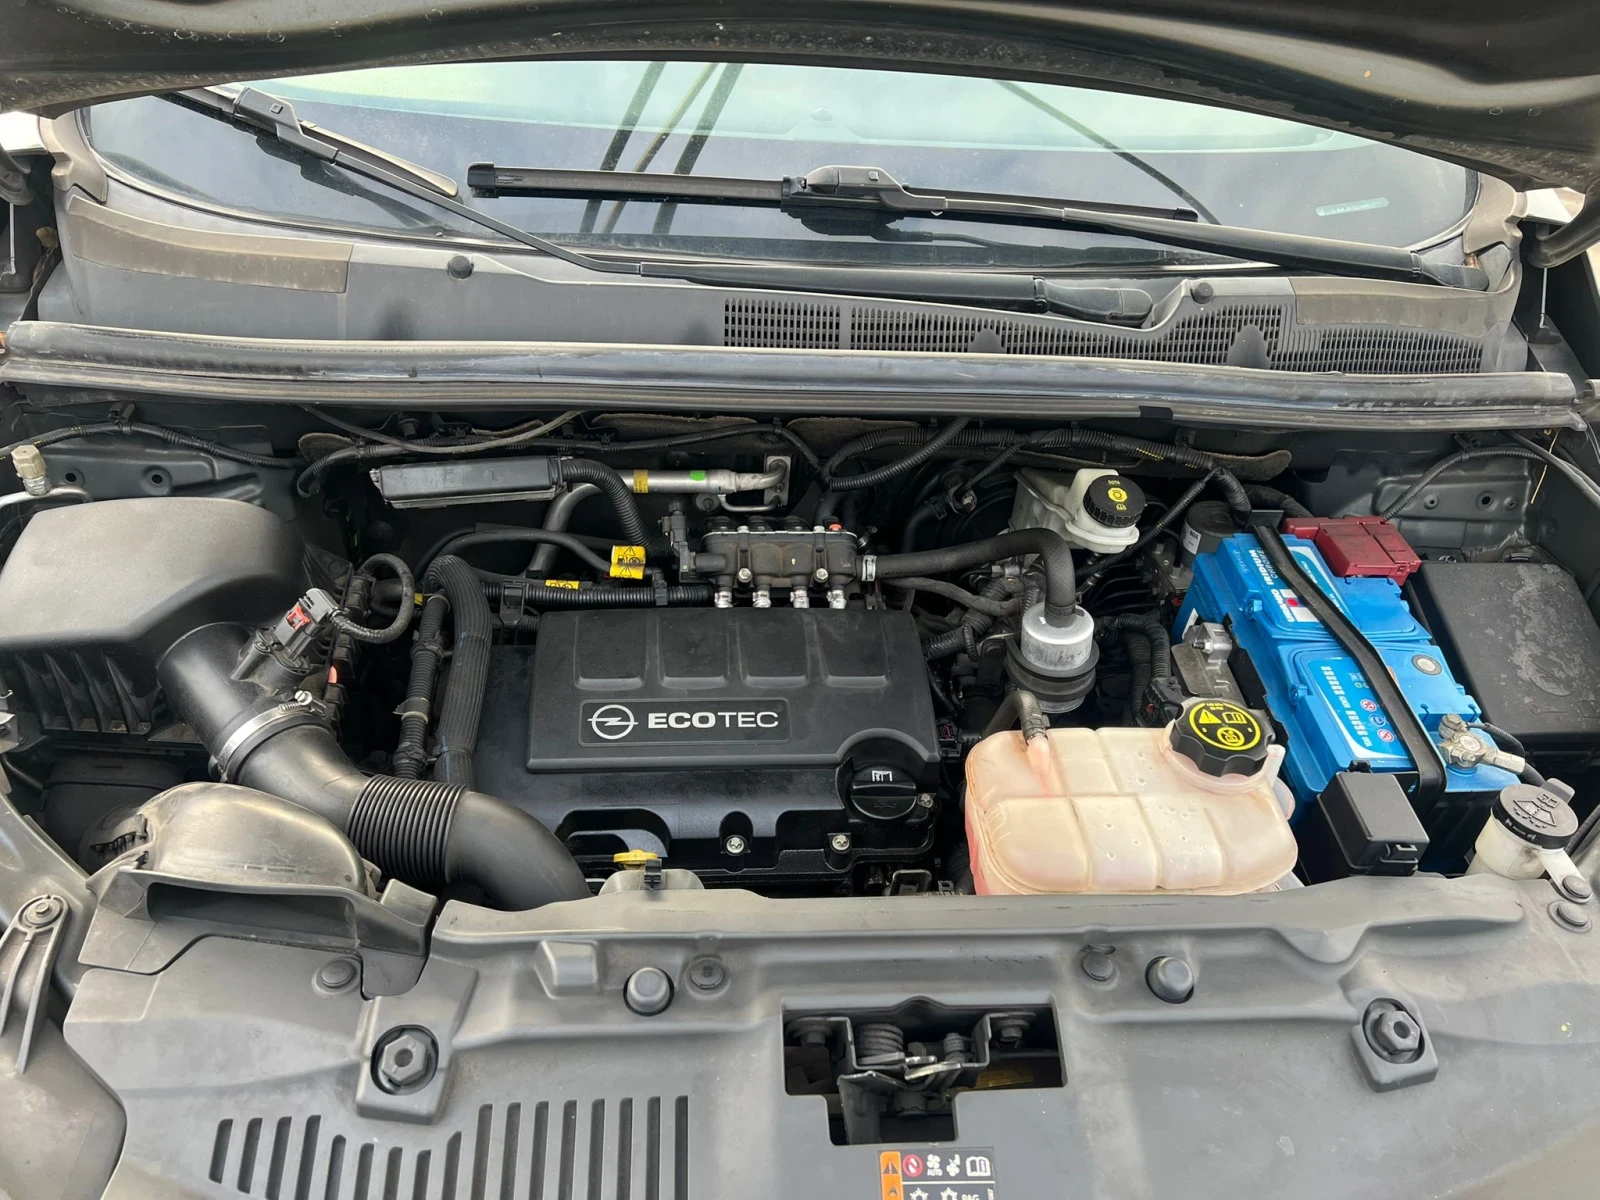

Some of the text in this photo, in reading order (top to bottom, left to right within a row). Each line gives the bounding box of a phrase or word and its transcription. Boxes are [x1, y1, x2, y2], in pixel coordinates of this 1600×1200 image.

[1248, 549, 1275, 586] IRIDIUM
[647, 711, 779, 729] ECOTEC
[927, 1168, 943, 1177] AUTO
